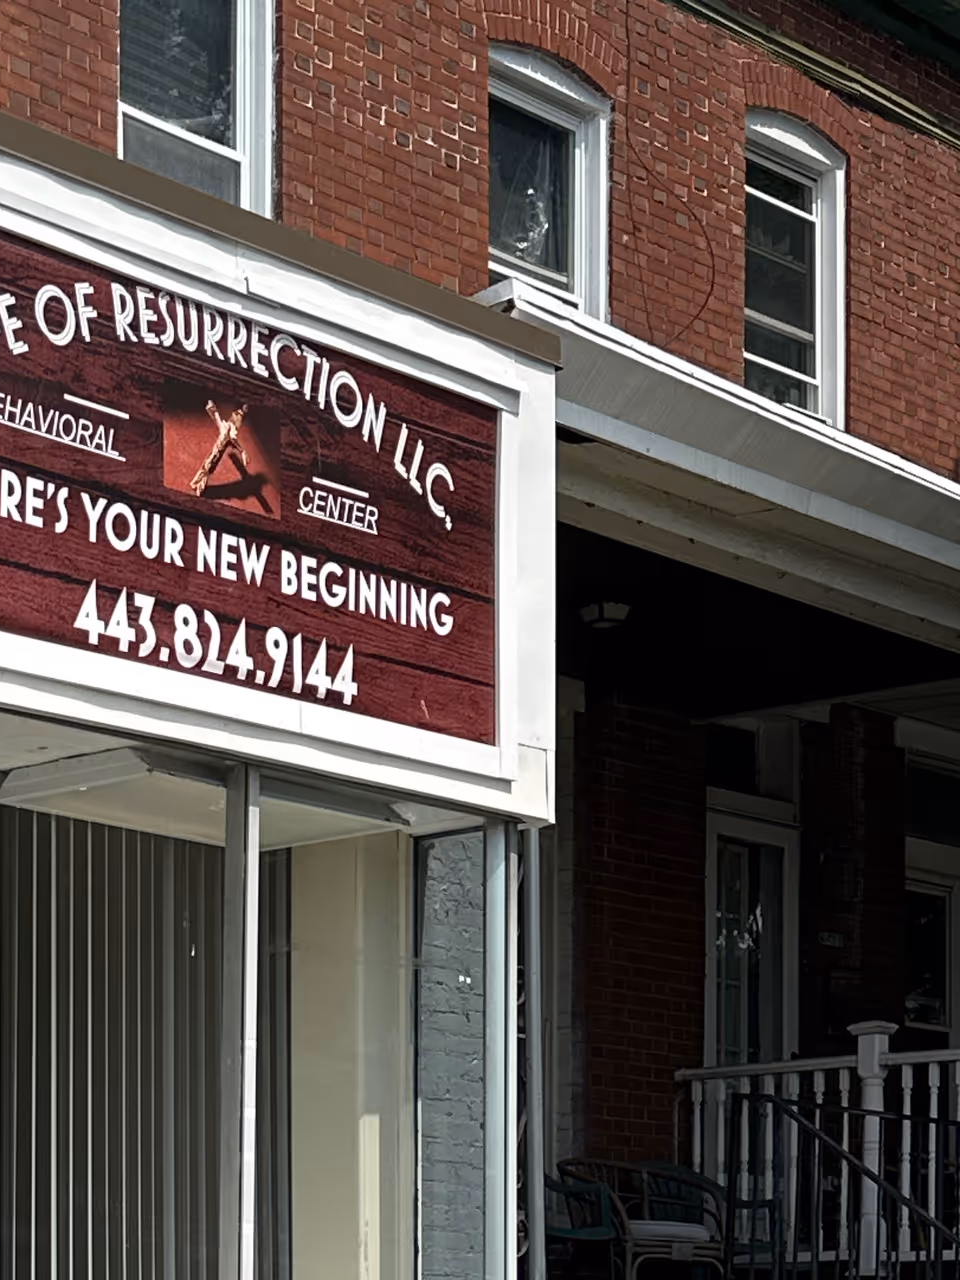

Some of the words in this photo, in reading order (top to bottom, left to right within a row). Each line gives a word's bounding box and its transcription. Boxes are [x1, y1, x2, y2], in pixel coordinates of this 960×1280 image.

[34, 282, 98, 346] OF
[110, 281, 387, 453] RESURRECTION
[80, 491, 185, 567] YOUR
[196, 526, 271, 587] NEW
[280, 549, 454, 636] BEGINNING
[298, 486, 379, 532] CENTER
[72, 577, 358, 706] 443.824.9144
